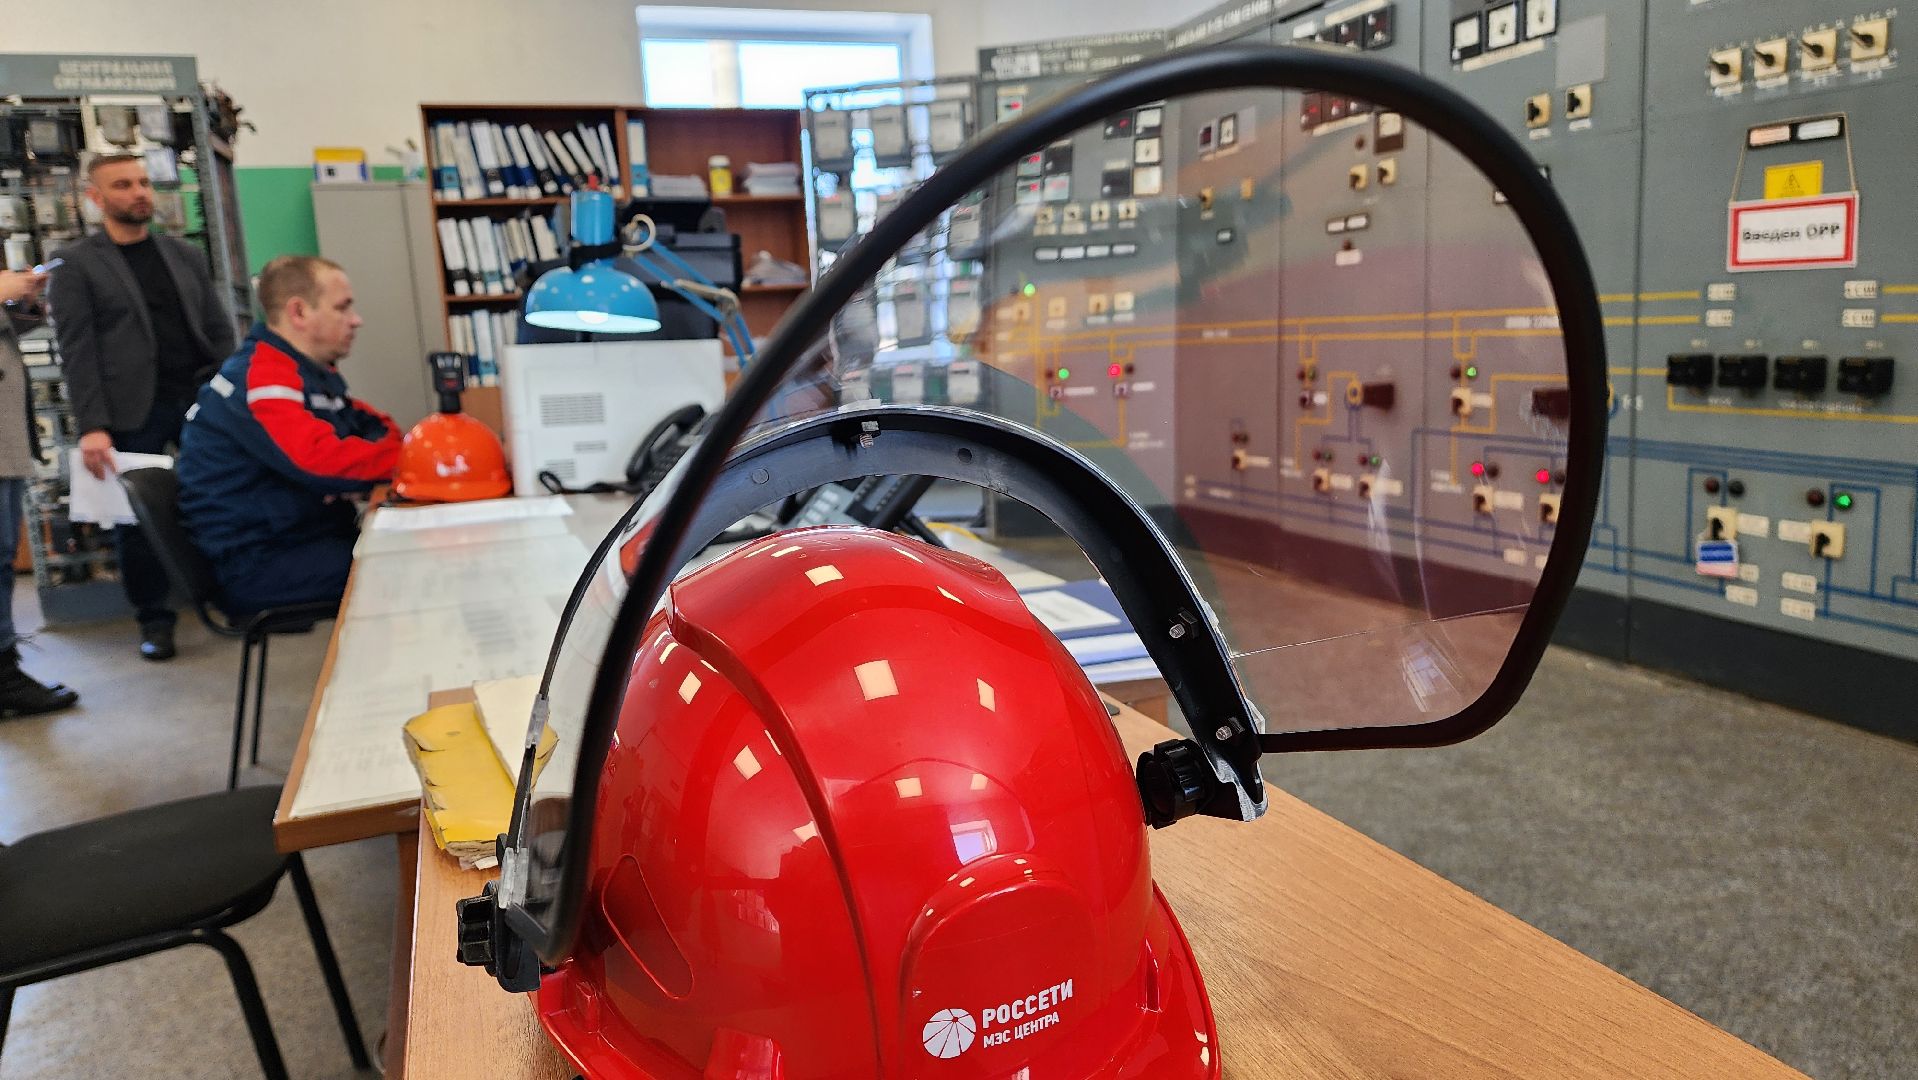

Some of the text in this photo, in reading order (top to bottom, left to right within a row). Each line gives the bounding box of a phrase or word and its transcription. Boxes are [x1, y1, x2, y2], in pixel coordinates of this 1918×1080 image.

[982, 978, 1073, 1028] РОССЕТИ
[983, 1012, 1060, 1048] МЭС ЦЕНТРА
